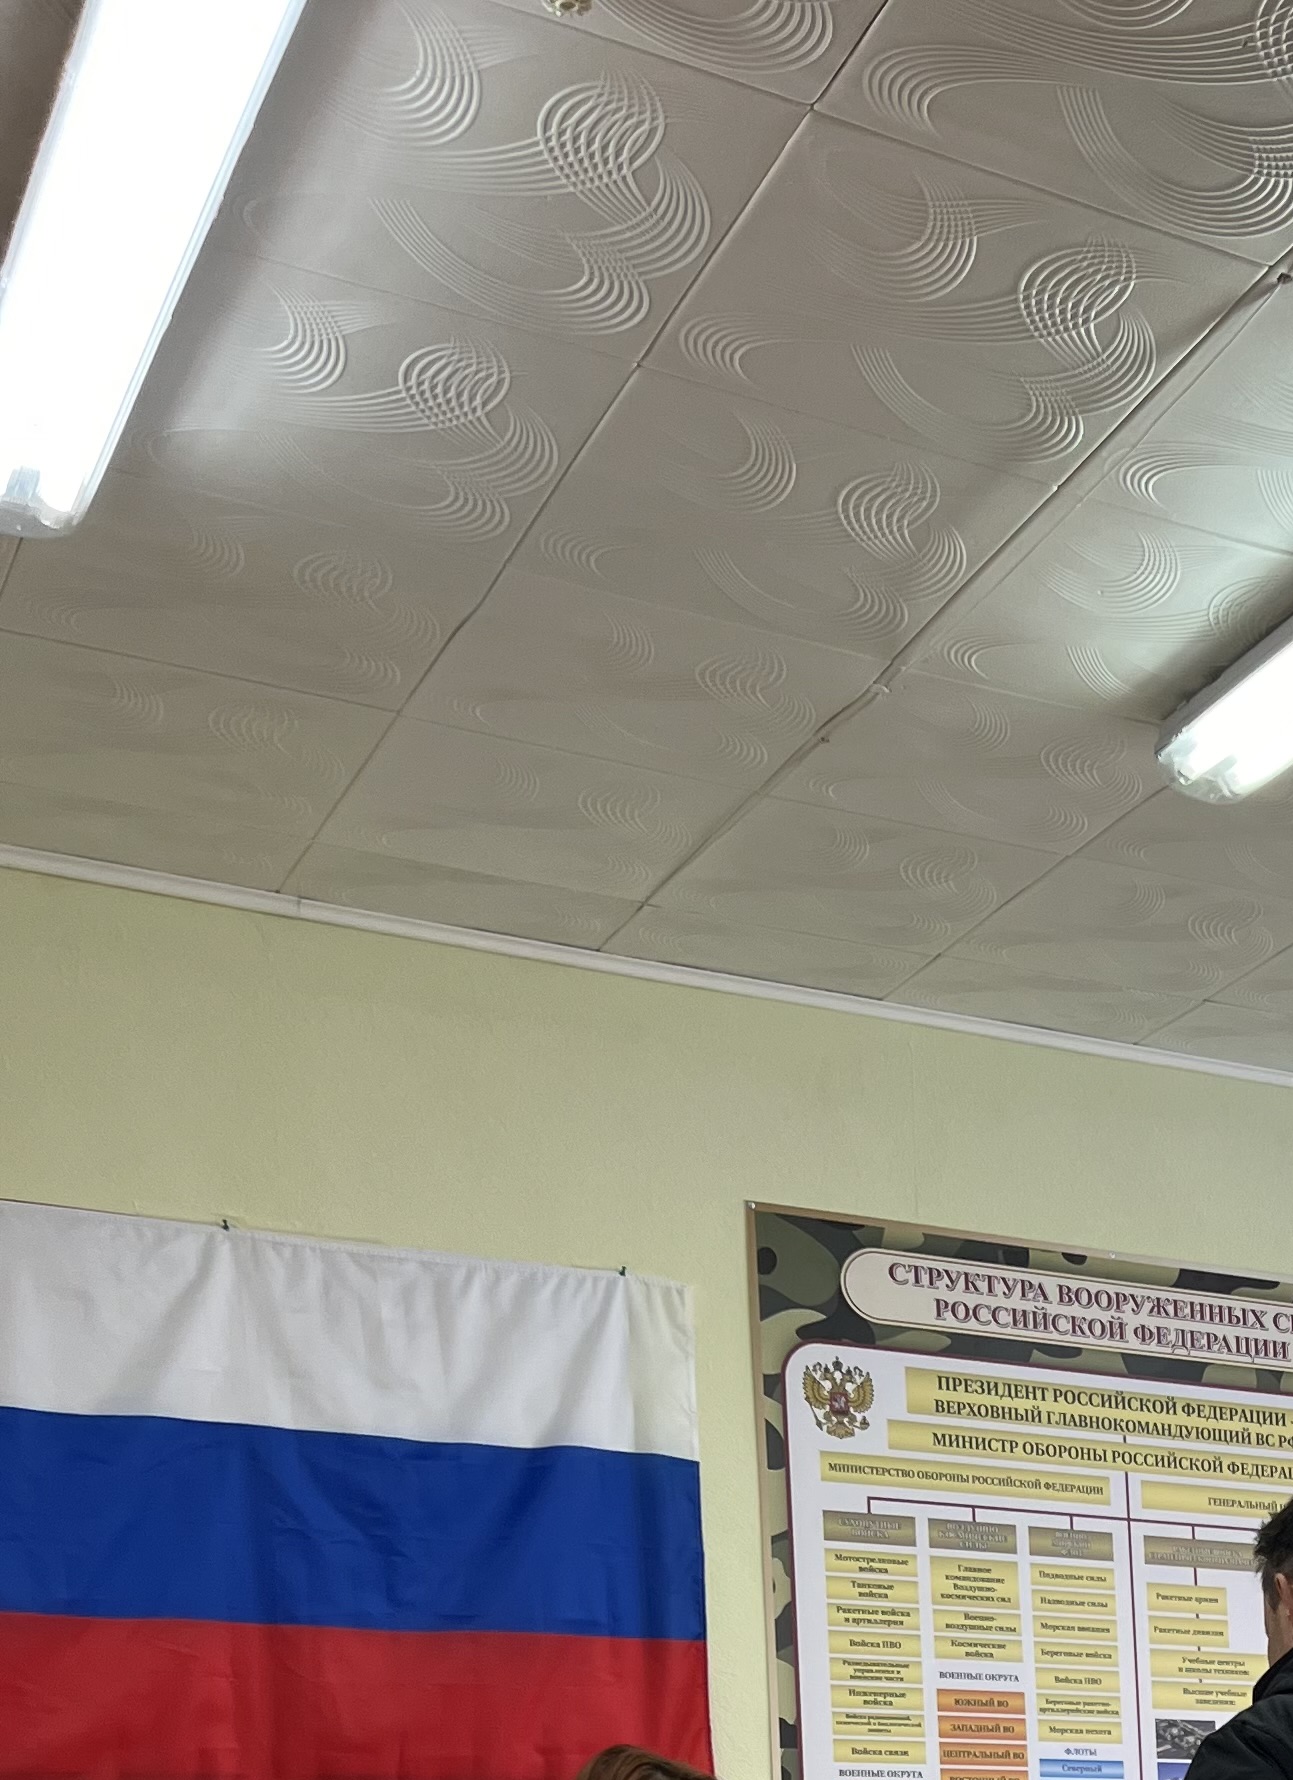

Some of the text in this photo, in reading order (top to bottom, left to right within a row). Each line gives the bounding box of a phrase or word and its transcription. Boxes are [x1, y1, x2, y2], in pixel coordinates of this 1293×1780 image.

[888, 1262, 1050, 1303] СТРУКТУРА
[1057, 1283, 1267, 1331] ВООРУЖЕННЫХ
[934, 1297, 1291, 1362] РОССИЙСКОЙ ФЕДЕРАЦИИ
[936, 1375, 1047, 1405] ПРЕЗИДЕНТ
[1050, 1385, 1176, 1416] РОССИЙСКОЙ
[1180, 1398, 1286, 1427] ФЕДЕРАЦИИ
[933, 1396, 1042, 1425] ВЕРХОВНЫЙ
[1046, 1409, 1251, 1446] ГЛАВНОКОМАНДУЮЩИЙ
[1255, 1430, 1275, 1446] ВС
[932, 1432, 1018, 1454] МИНИСТР
[1021, 1440, 1109, 1464] ОБОРОНЫ
[1111, 1447, 1223, 1474] РОССИЙСКОЙ
[829, 1462, 1103, 1495] МИНИСТЕРСТВО ОБОРОНЫ РОССИЙСКОЙ ФЕДЕРАЦИИ
[1208, 1497, 1278, 1512] ГЕНЕРАЛЬНЫЙ
[858, 1565, 888, 1574] войска
[858, 1590, 888, 1599] войска
[836, 1606, 911, 1618] Ракетные войска
[849, 1639, 902, 1650] Войска ПВО
[964, 1650, 994, 1658] войска
[939, 1671, 1019, 1682] ВОЕННЫЕ ОКРУГА
[1054, 1675, 1102, 1685] Войска ПВО
[848, 1688, 907, 1699] Инженерные
[863, 1697, 893, 1706] войска
[954, 1697, 1009, 1708] ЮЖНЫЙ ВО
[950, 1723, 1015, 1734] ЗАПАДНЫЙ ВО
[1049, 1725, 1084, 1736] Морская
[851, 1746, 882, 1756] Войска
[943, 1750, 1025, 1760] ЦЕНТРАЛЬНЫЙ ВО
[1064, 1748, 1097, 1757] ФЛОТЫ
[839, 1769, 923, 1779] ВОЕННЫЕ ОКРУГА
[1062, 1764, 1103, 1775] Северный
